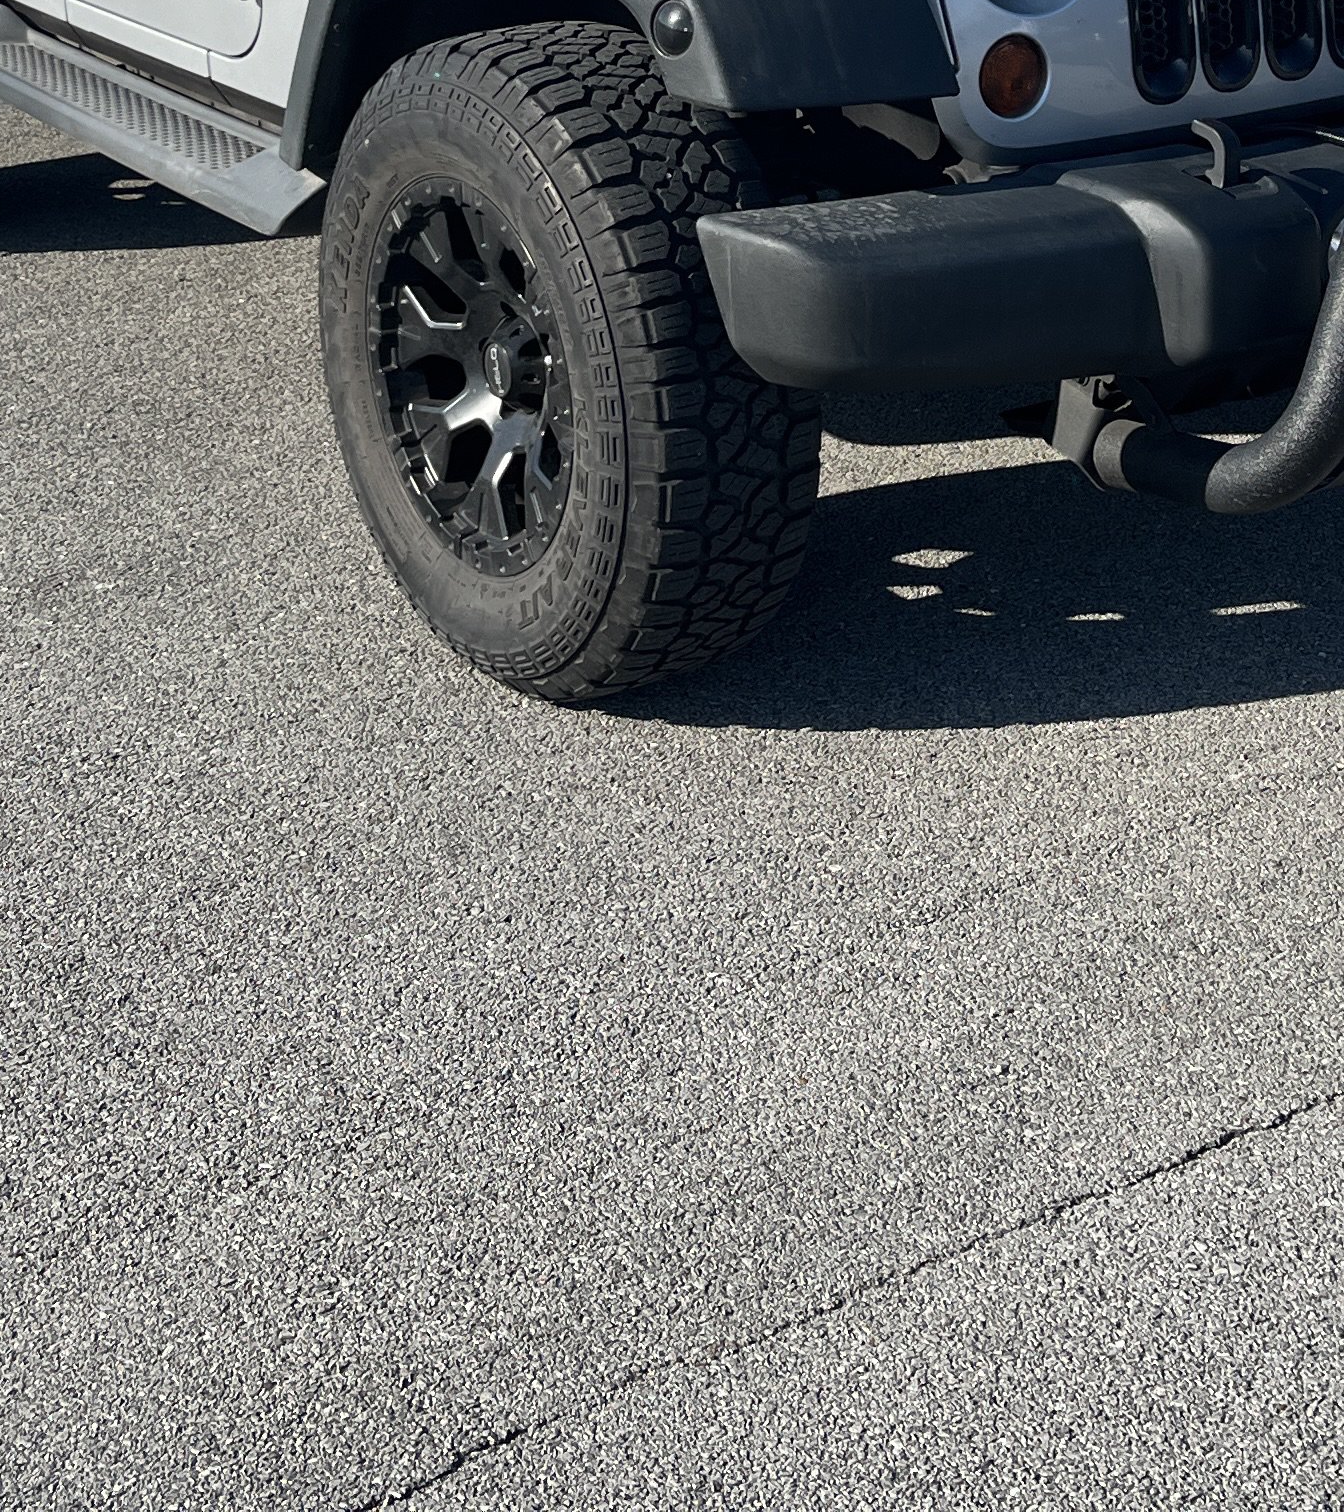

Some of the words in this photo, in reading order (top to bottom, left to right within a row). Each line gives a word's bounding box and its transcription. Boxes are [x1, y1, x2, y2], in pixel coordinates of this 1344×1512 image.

[330, 174, 371, 314] KENDA
[557, 396, 590, 583] KLEVER
[518, 571, 554, 631] A/T
